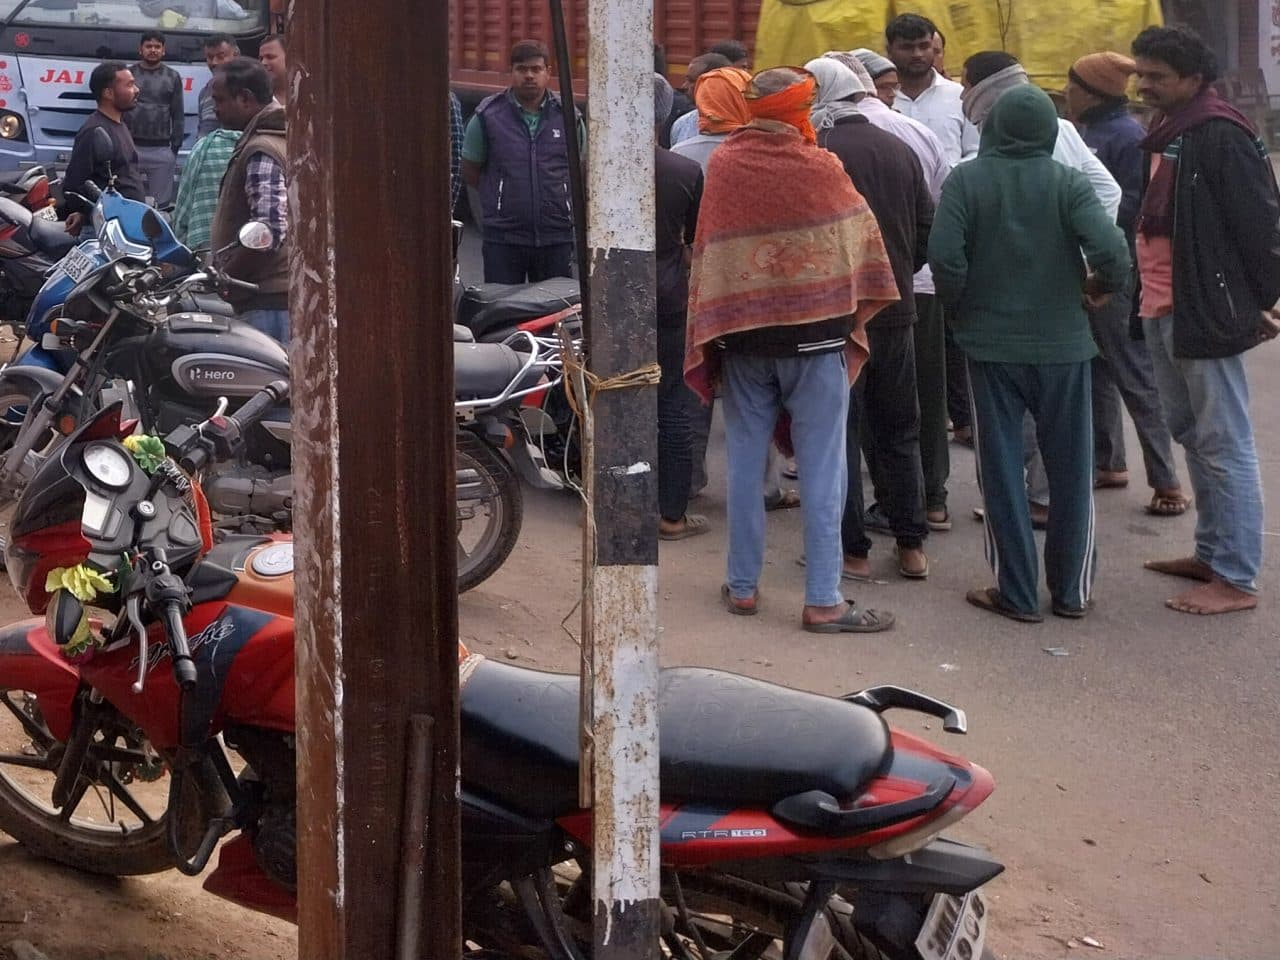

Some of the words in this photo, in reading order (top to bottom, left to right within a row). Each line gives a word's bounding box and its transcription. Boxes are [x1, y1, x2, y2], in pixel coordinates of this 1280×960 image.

[40, 69, 85, 84] JAI
[204, 370, 235, 380] Hero
[681, 830, 729, 839] RTR
